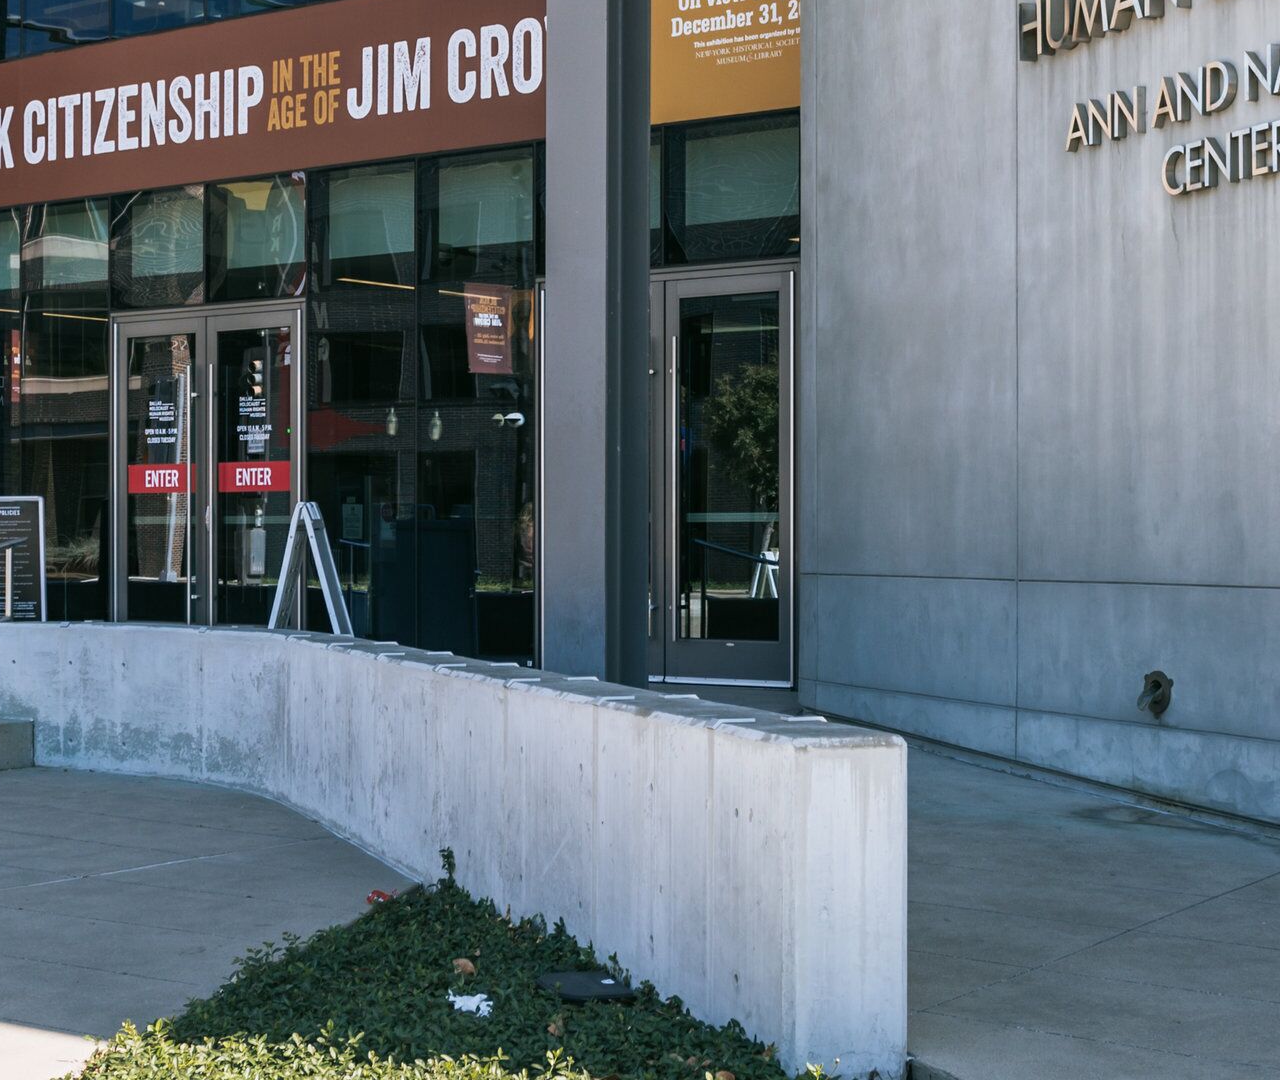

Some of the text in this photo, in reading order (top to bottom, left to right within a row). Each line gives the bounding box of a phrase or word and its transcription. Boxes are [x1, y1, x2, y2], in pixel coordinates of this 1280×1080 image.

[671, 10, 753, 37] December
[759, 2, 782, 25] 31,
[732, 41, 772, 53] HISTORICAL
[776, 37, 800, 47] SOCIET
[272, 51, 341, 94] IN THE
[347, 16, 547, 120] JIM CRO
[23, 65, 264, 164] CITIZENSHIP
[267, 88, 341, 131] AGE OF
[1065, 86, 1146, 152] ANN
[1152, 61, 1238, 128] AND
[145, 469, 179, 488] ENTER
[235, 467, 272, 486] ENTER
